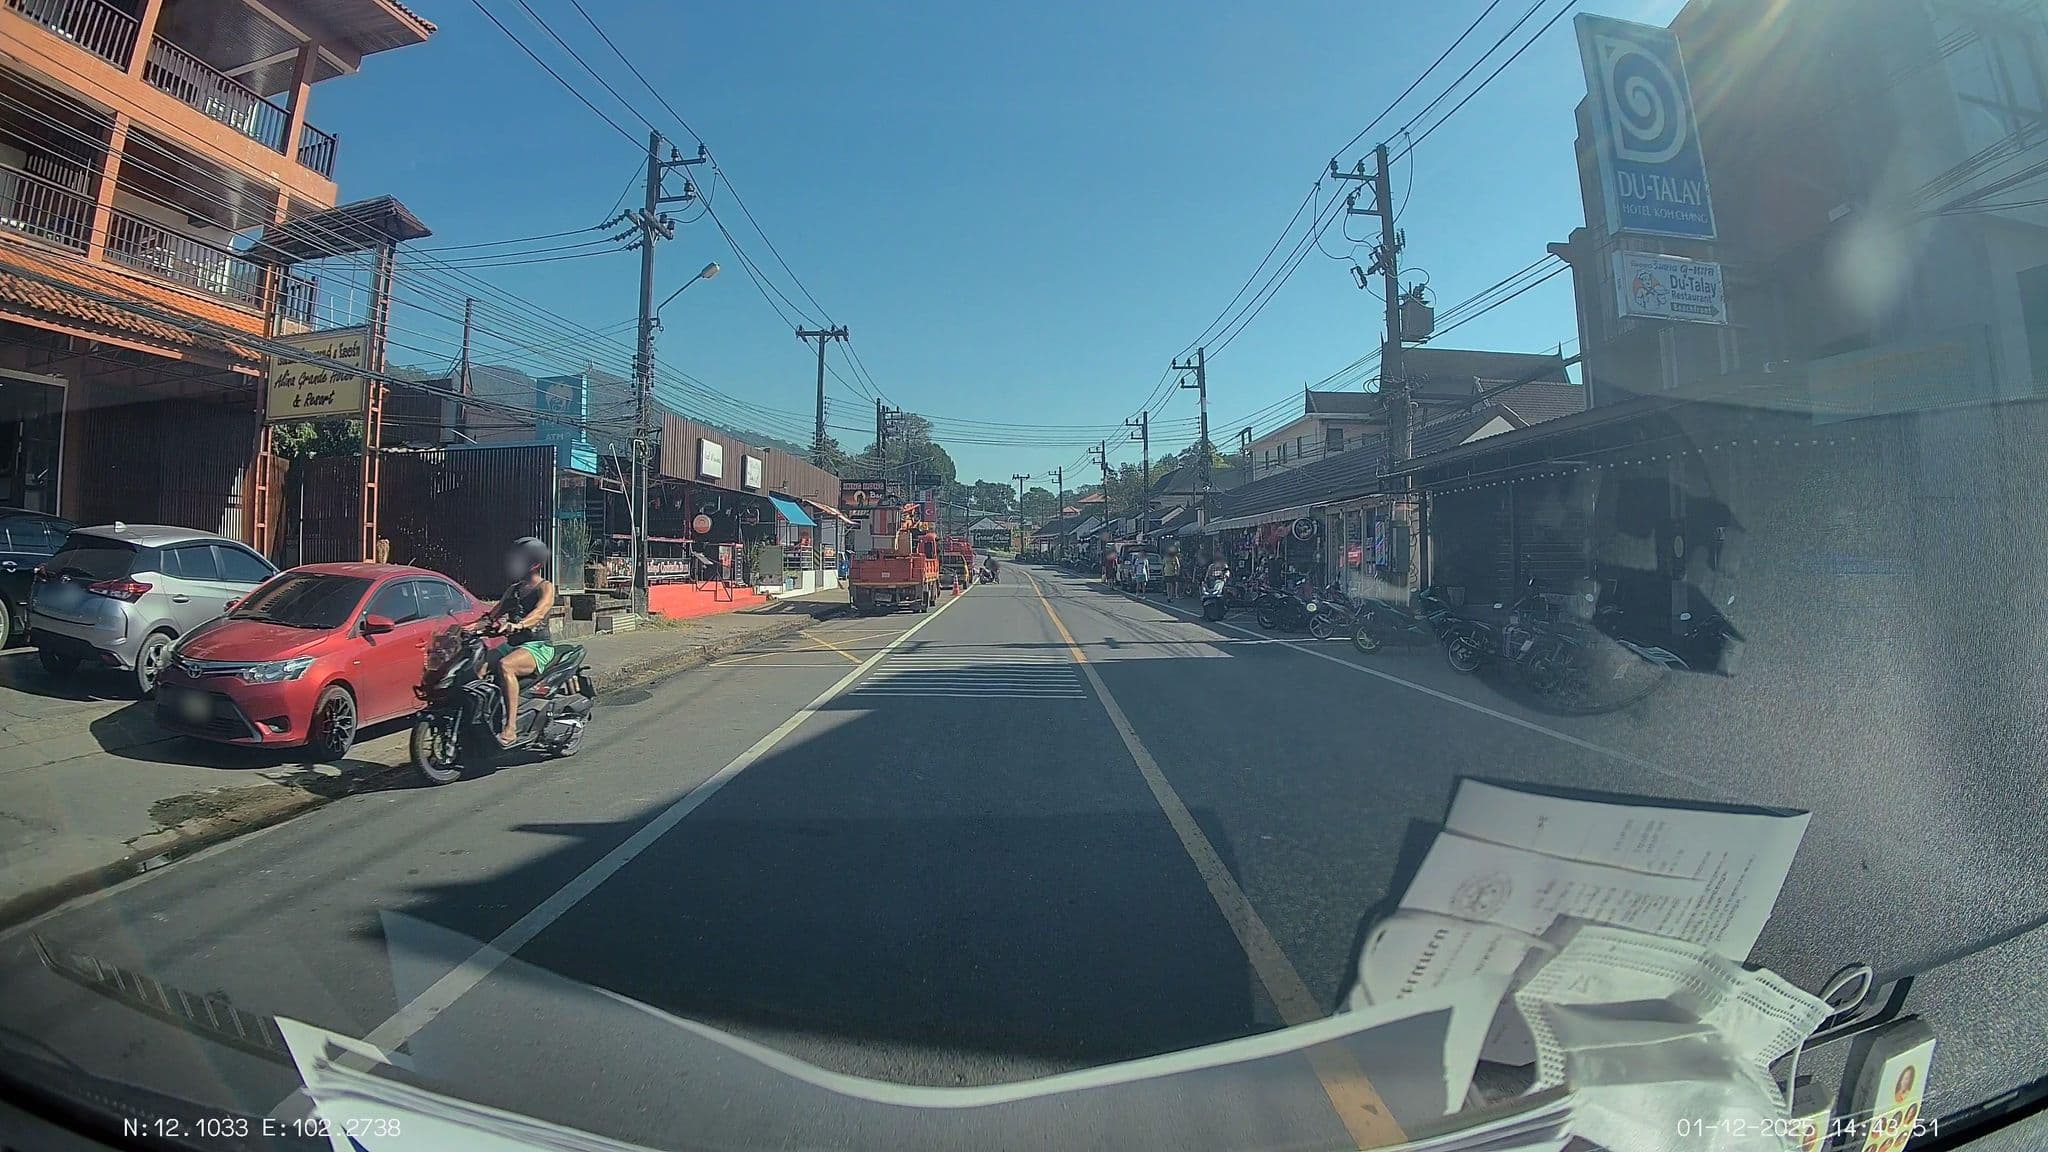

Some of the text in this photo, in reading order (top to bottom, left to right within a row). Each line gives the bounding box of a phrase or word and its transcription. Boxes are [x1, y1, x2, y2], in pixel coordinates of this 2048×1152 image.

[1617, 170, 1702, 206] DU-TALAY
[1623, 202, 1708, 224] HOTEL KOH CHANG
[1669, 274, 1717, 298] Du-Talay
[1671, 290, 1713, 304] Restaurant
[293, 390, 335, 408] & Resort
